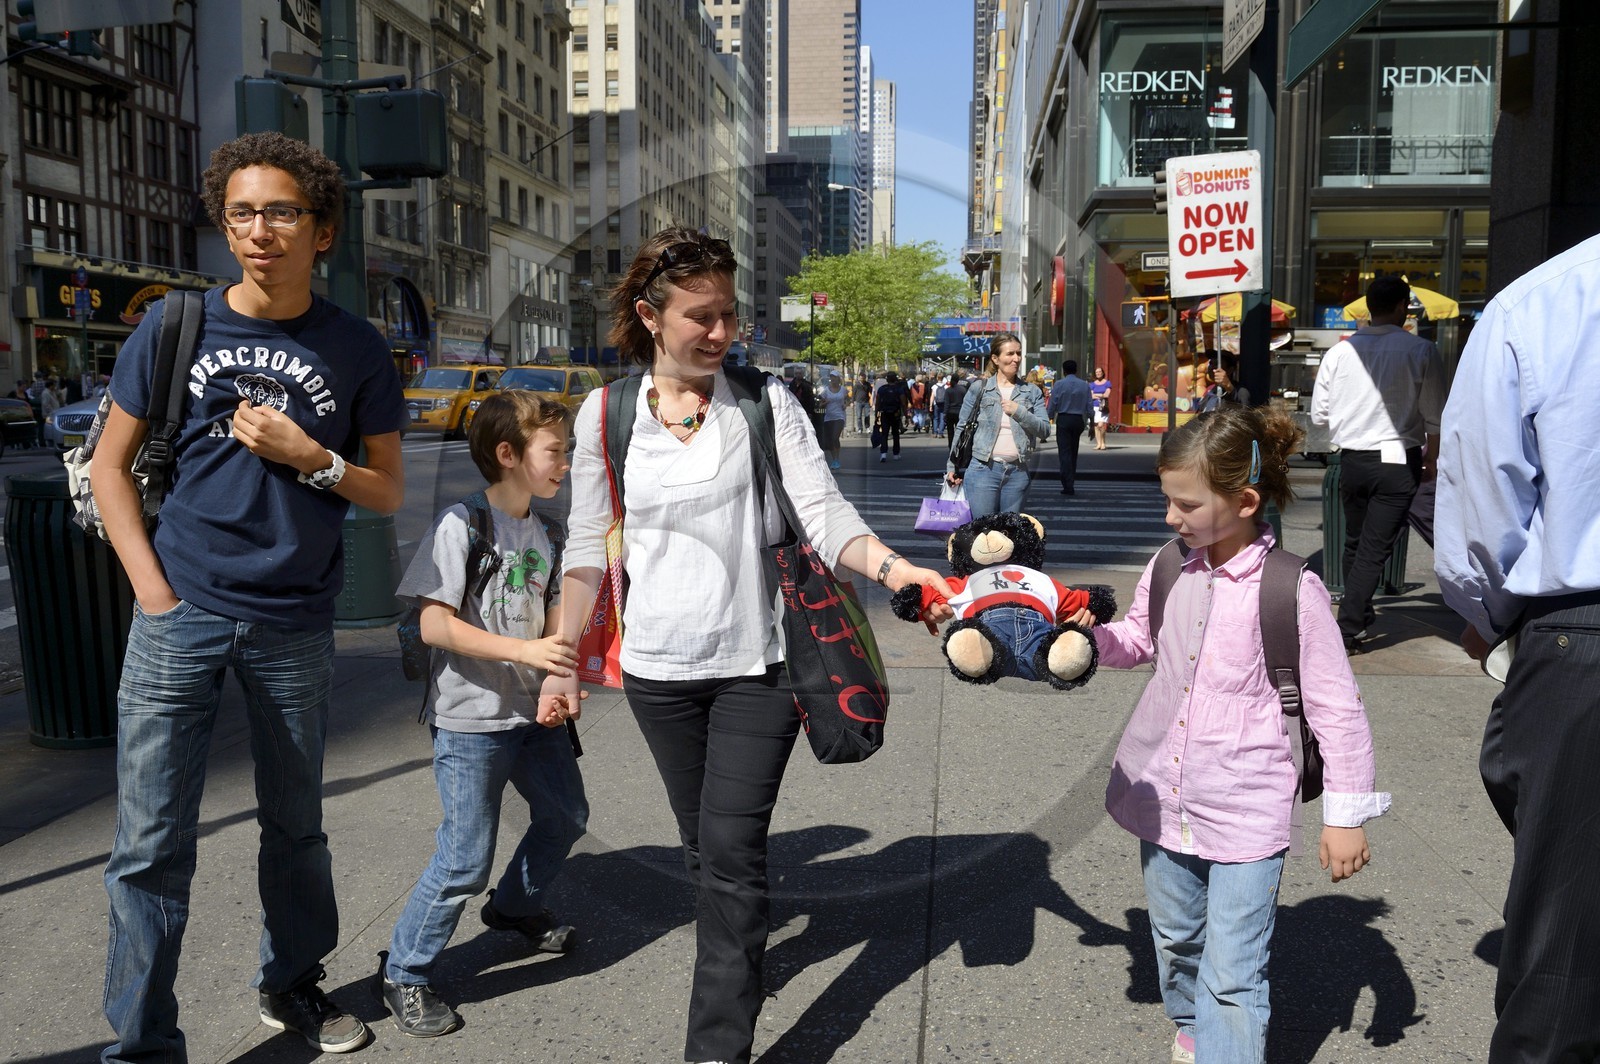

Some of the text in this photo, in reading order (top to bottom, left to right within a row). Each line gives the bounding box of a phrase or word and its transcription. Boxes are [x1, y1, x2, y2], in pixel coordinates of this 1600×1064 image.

[296, 0, 316, 28] ONE
[1100, 70, 1205, 93] REDKEN
[1382, 65, 1492, 88] REDKEN
[1194, 167, 1252, 182] DUNKIN'
[1194, 179, 1250, 194] DONUTS
[1184, 201, 1248, 229] NOW
[1179, 227, 1254, 257] OPEN
[1151, 257, 1166, 266] ONE
[967, 322, 1006, 332] GUESS
[188, 346, 337, 417] ABERCROMBIE
[991, 571, 1000, 581] I
